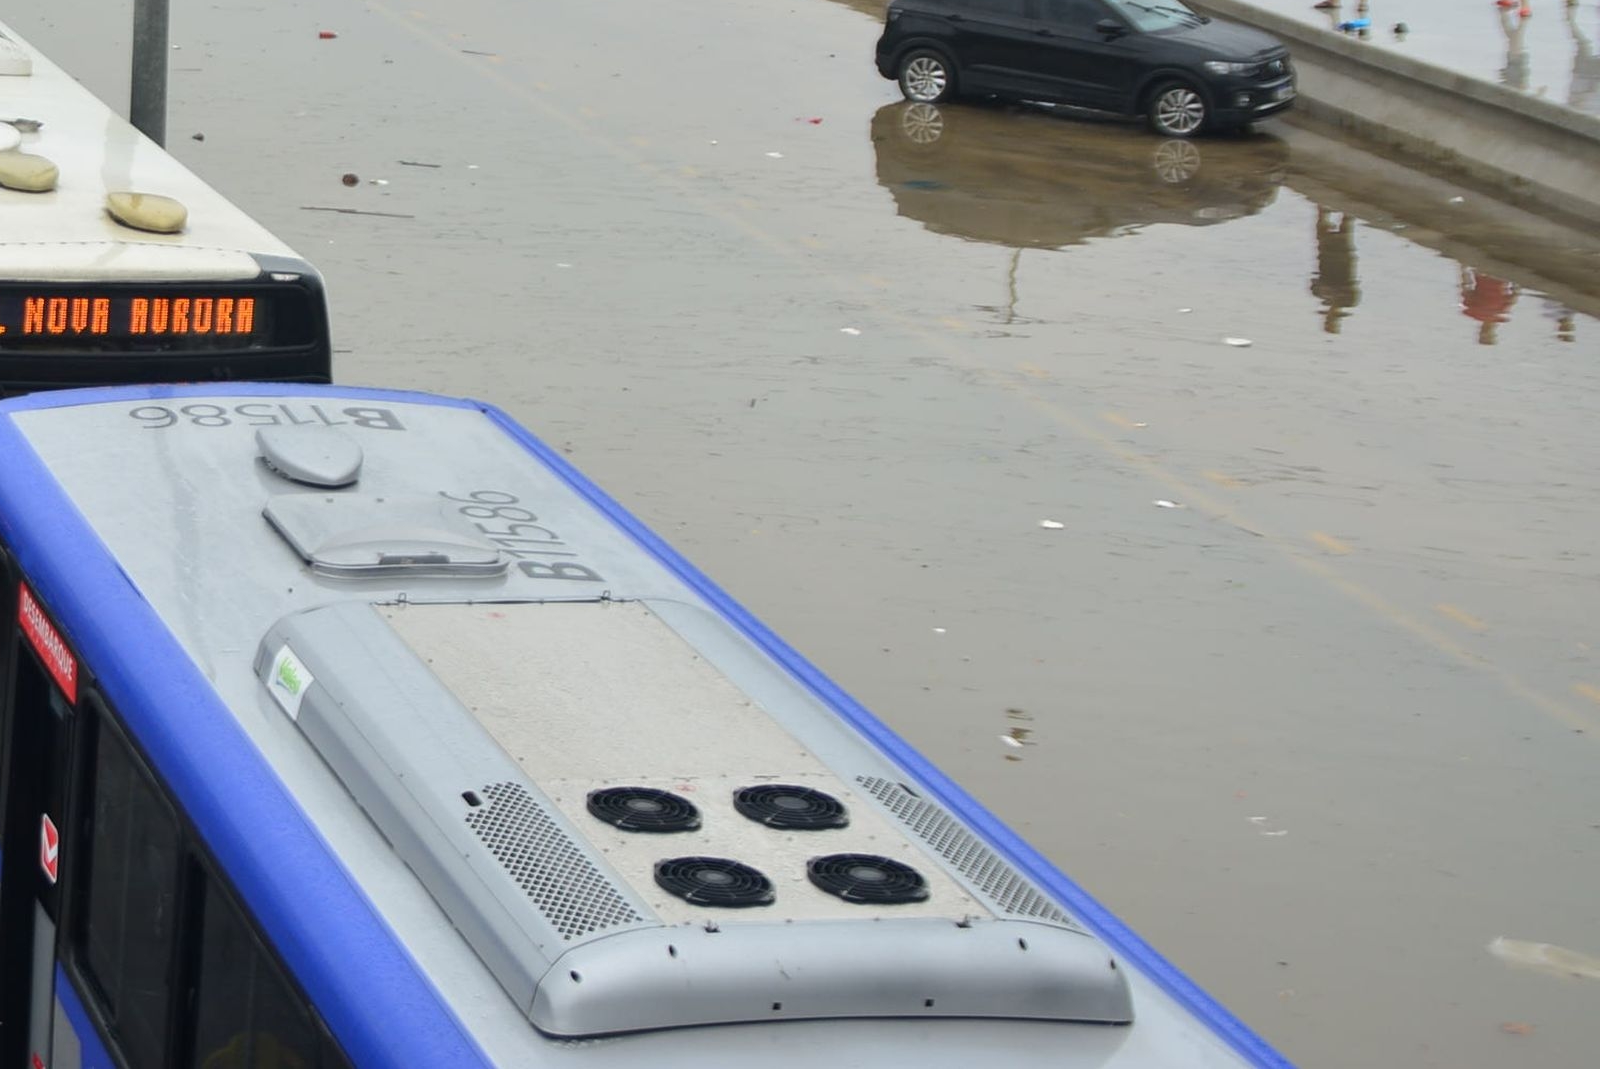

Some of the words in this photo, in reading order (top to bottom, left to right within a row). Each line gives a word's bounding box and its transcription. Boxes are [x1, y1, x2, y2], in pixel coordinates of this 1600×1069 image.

[23, 297, 110, 335] NOVA
[129, 297, 255, 335] AURORA
[129, 403, 406, 430] B11586
[439, 490, 605, 582] B11586
[24, 590, 73, 681] DESEMBARQUE
